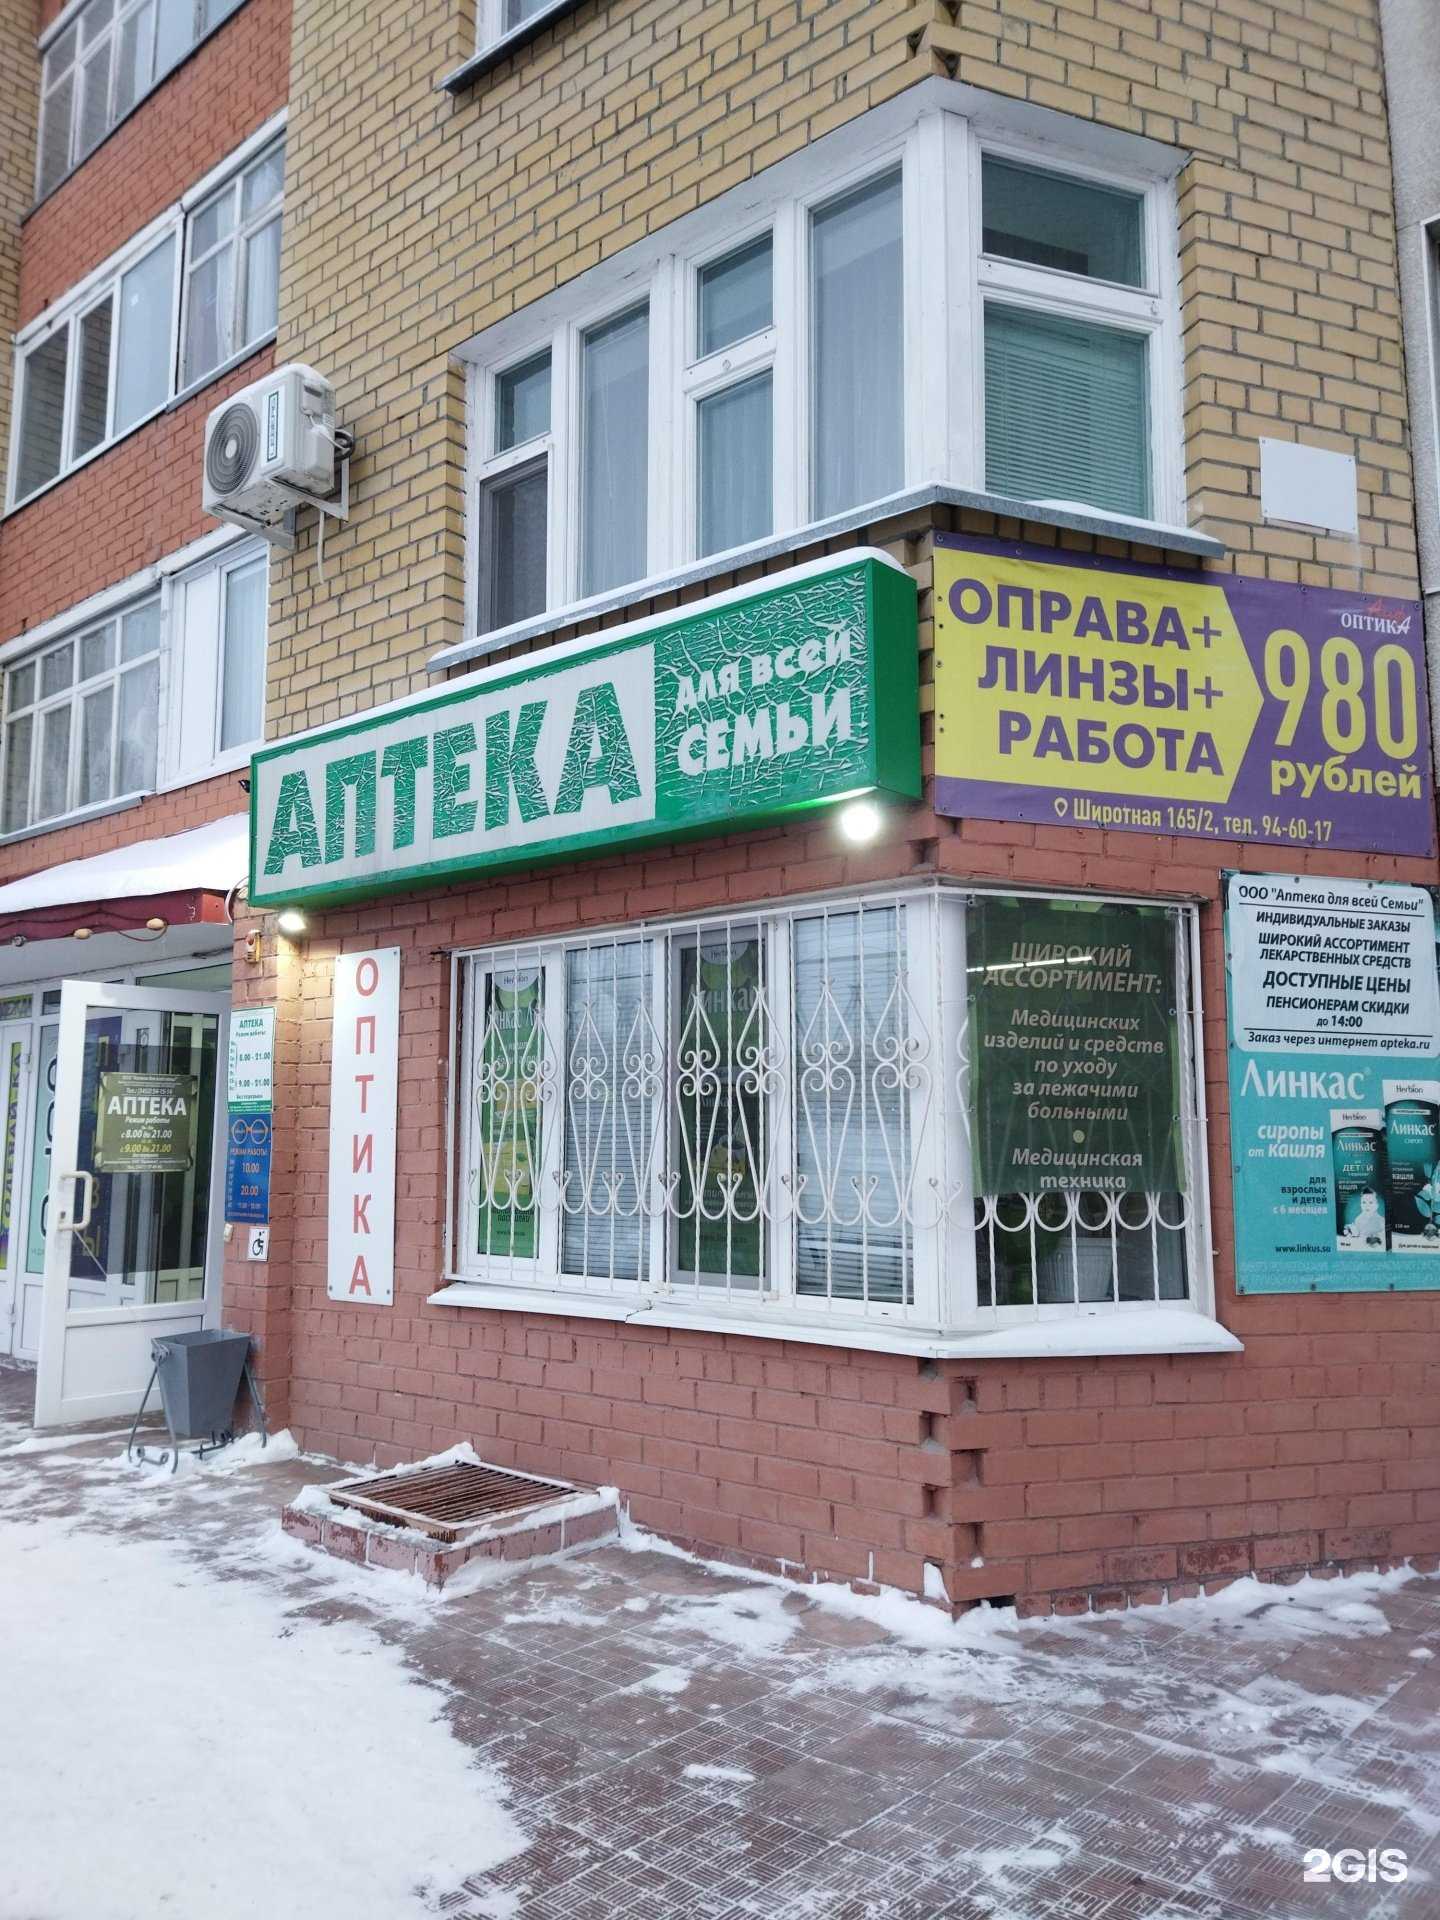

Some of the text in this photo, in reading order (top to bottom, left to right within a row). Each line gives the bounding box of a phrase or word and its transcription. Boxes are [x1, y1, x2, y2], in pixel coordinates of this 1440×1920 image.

[948, 578, 1222, 651] ОПРАВА+
[979, 645, 1223, 711] ЛИНЗЫ+
[1264, 629, 1418, 760] 980
[678, 688, 852, 777] СЕМЬИ
[999, 711, 1224, 776] РАБОТА
[263, 681, 643, 876] АПТЕКА
[1271, 753, 1422, 799] рублей
[1073, 798, 1333, 842] Широтная 165/2, тел. 94-60-17
[1239, 885, 1269, 900] ООО
[1327, 891, 1350, 906] для
[1351, 894, 1379, 909] всей
[1256, 911, 1411, 933] ИНДИВИДУАЛЬНЫЕ ЗАКАЗЫ
[1258, 932, 1410, 954] ШИРОКИЙ АССОРТИМЕНТ
[1011, 942, 1132, 968] ШИРОКИЙ
[1260, 948, 1411, 969] ЛЕКАРСТВЕННЫХ СРЕДСТВ
[983, 967, 1162, 994] АССОРТИМЕНТ:
[1263, 970, 1411, 995] ДОСТУПНЫЕ ЦЕНЫ
[1266, 995, 1410, 1016] ПЕНСИОНЕРАМ СКИДКИ
[239, 1018, 264, 1029] АПТЕКА
[1011, 1009, 1140, 1031] Медицинских
[1316, 1015, 1363, 1028] до 14:00
[984, 1031, 1164, 1056] изделий и средств
[1248, 1032, 1431, 1050] Заказ через интернет apteka.ru
[1034, 1057, 1118, 1078] по уходу
[1012, 1081, 1138, 1098] за лежачими
[1240, 1058, 1366, 1101] Линкас
[107, 1095, 187, 1116] АПТЕКА
[1028, 1101, 1128, 1121] больными
[151, 1129, 173, 1139] 21.00
[348, 957, 379, 1296] ОПТИКА
[1257, 1125, 1324, 1144] сиропы
[1391, 1120, 1436, 1137] Линкас
[1248, 1143, 1326, 1159] от кашля
[1337, 1139, 1377, 1152] Линкас
[1012, 1148, 1143, 1168] Медицинская
[1040, 1175, 1126, 1189] техника
[1281, 1186, 1327, 1195] взрослых
[1309, 1176, 1327, 1186] для
[1300, 1195, 1328, 1206] детей
